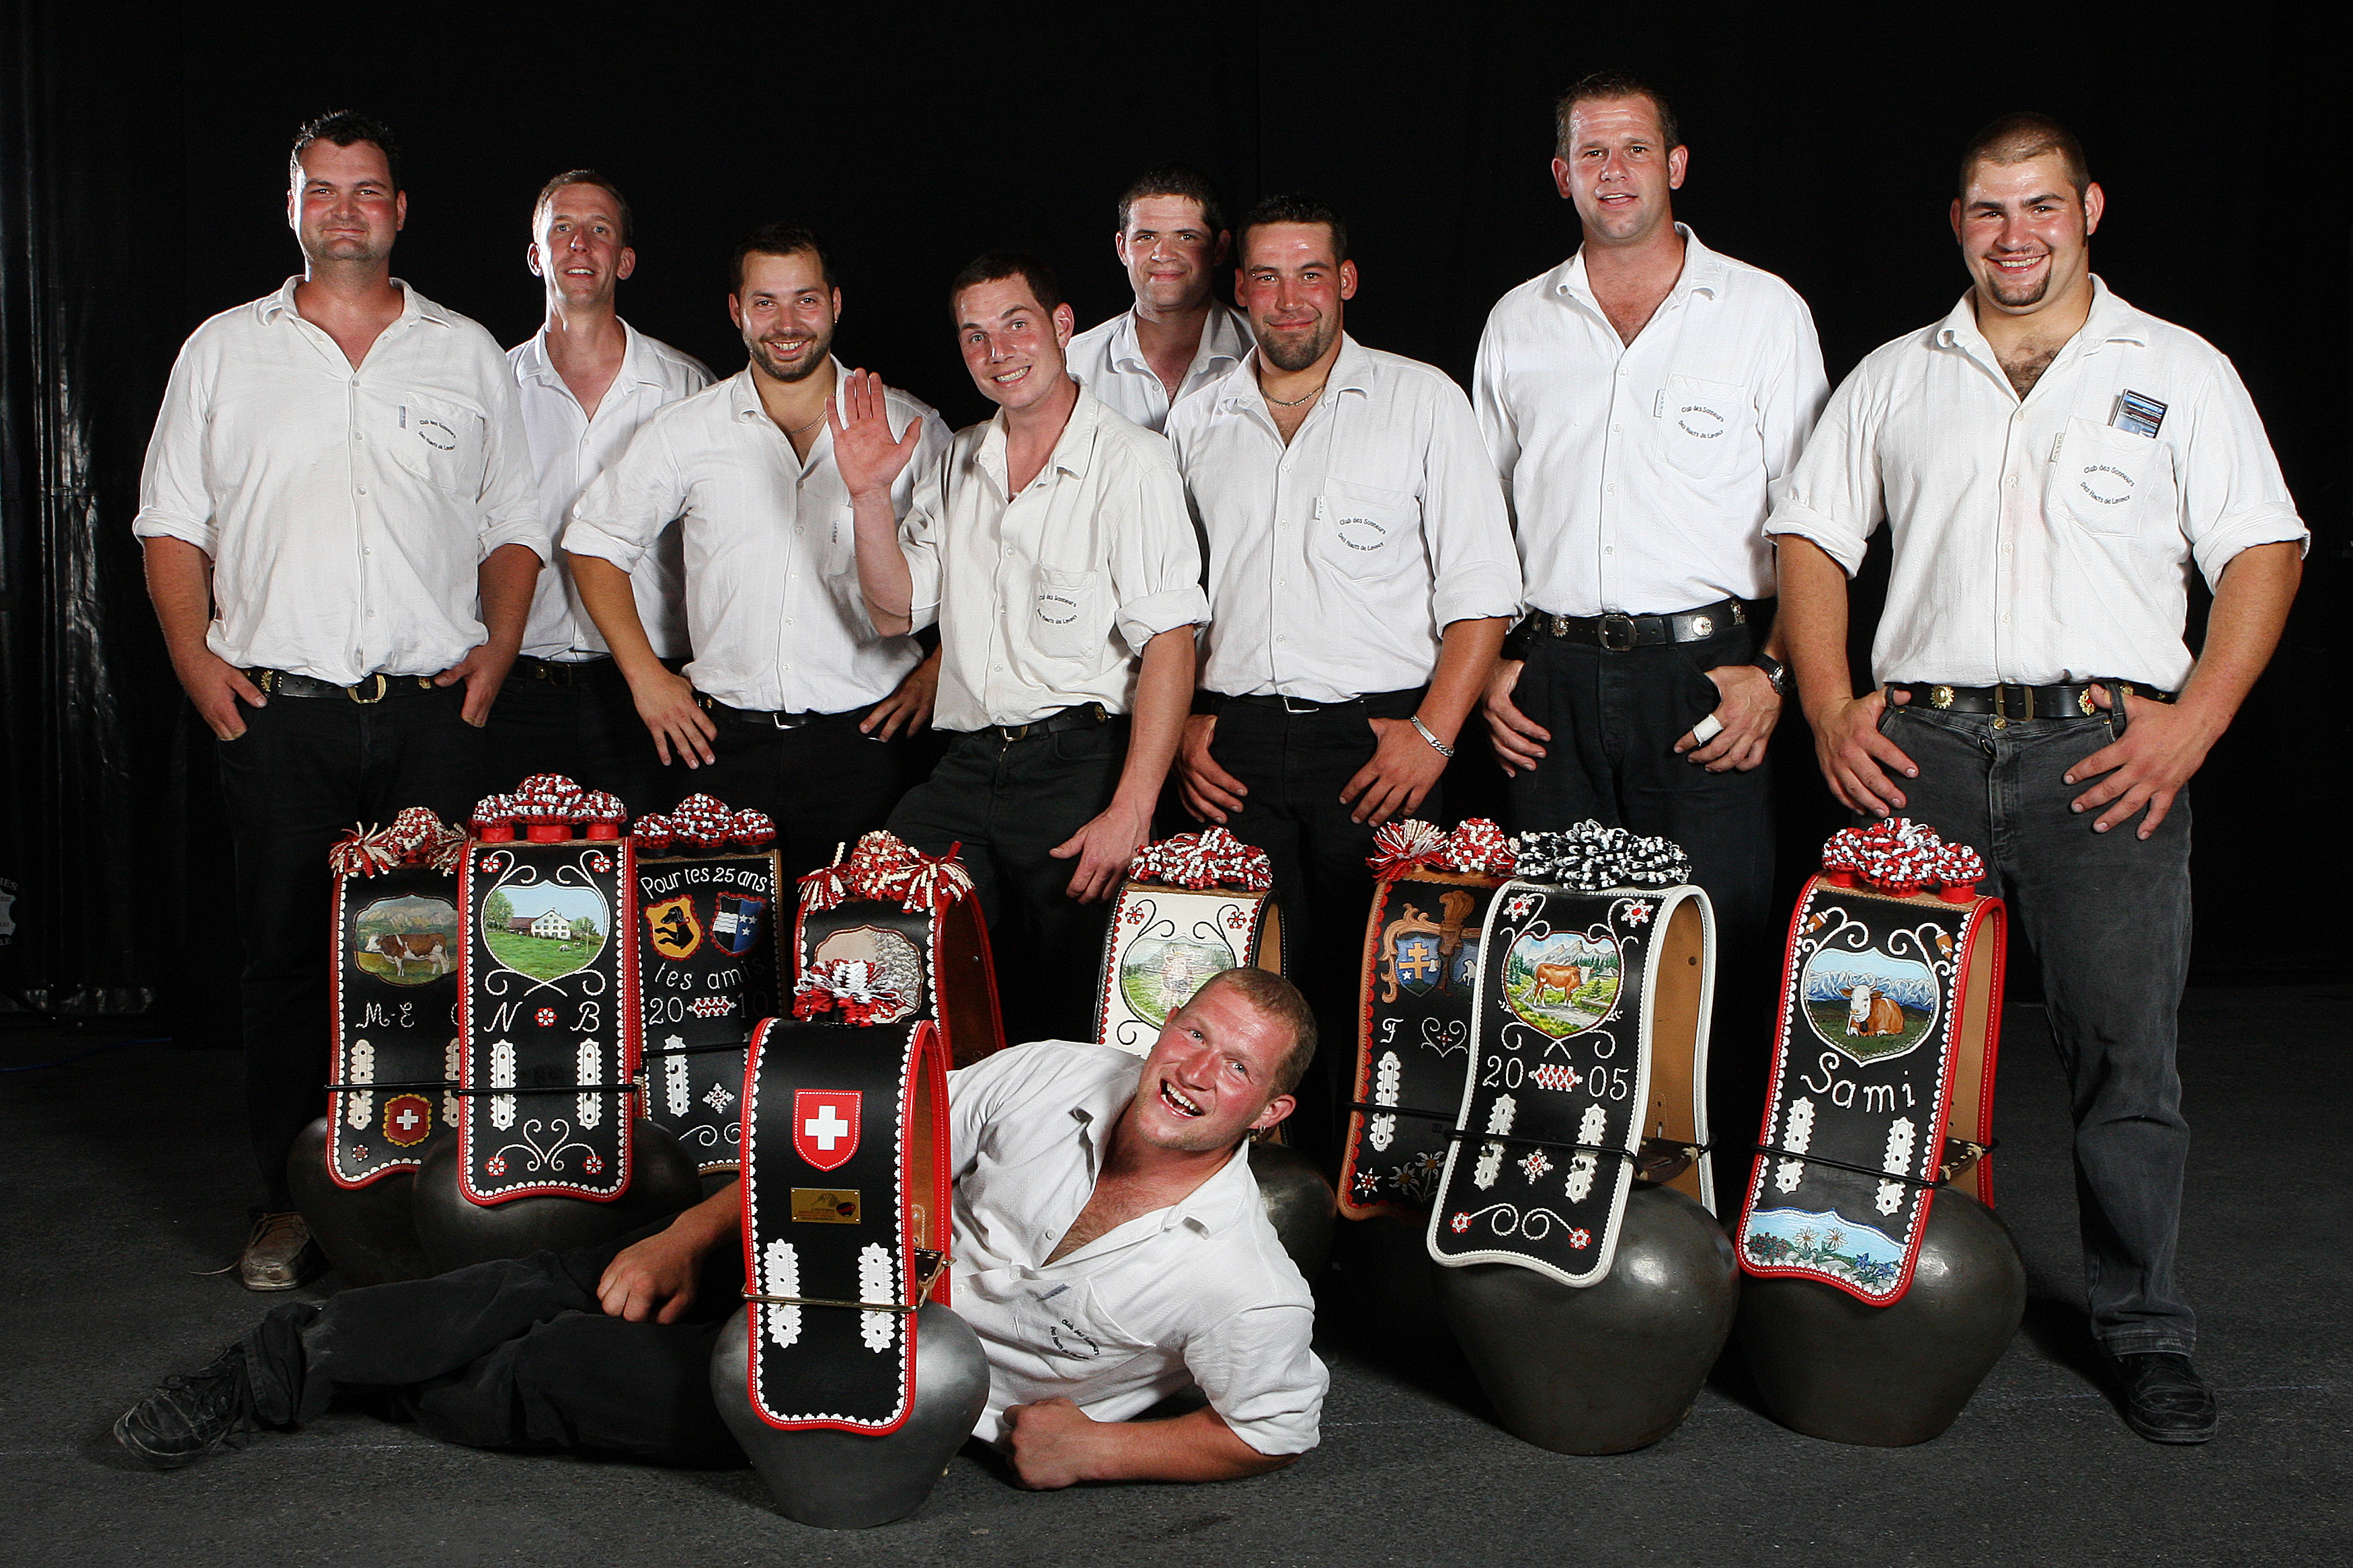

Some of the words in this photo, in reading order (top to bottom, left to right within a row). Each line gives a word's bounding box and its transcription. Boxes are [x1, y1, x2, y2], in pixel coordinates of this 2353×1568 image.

[641, 872, 681, 899] Pour
[684, 867, 710, 884] les
[712, 867, 735, 883] 25
[737, 870, 768, 892] ans
[483, 1001, 523, 1033] N
[569, 1001, 600, 1032] B
[648, 997, 684, 1025] 20
[1482, 1055, 1524, 1089] 20
[1589, 1065, 1630, 1101] 05
[1800, 1051, 1915, 1112] Sami
